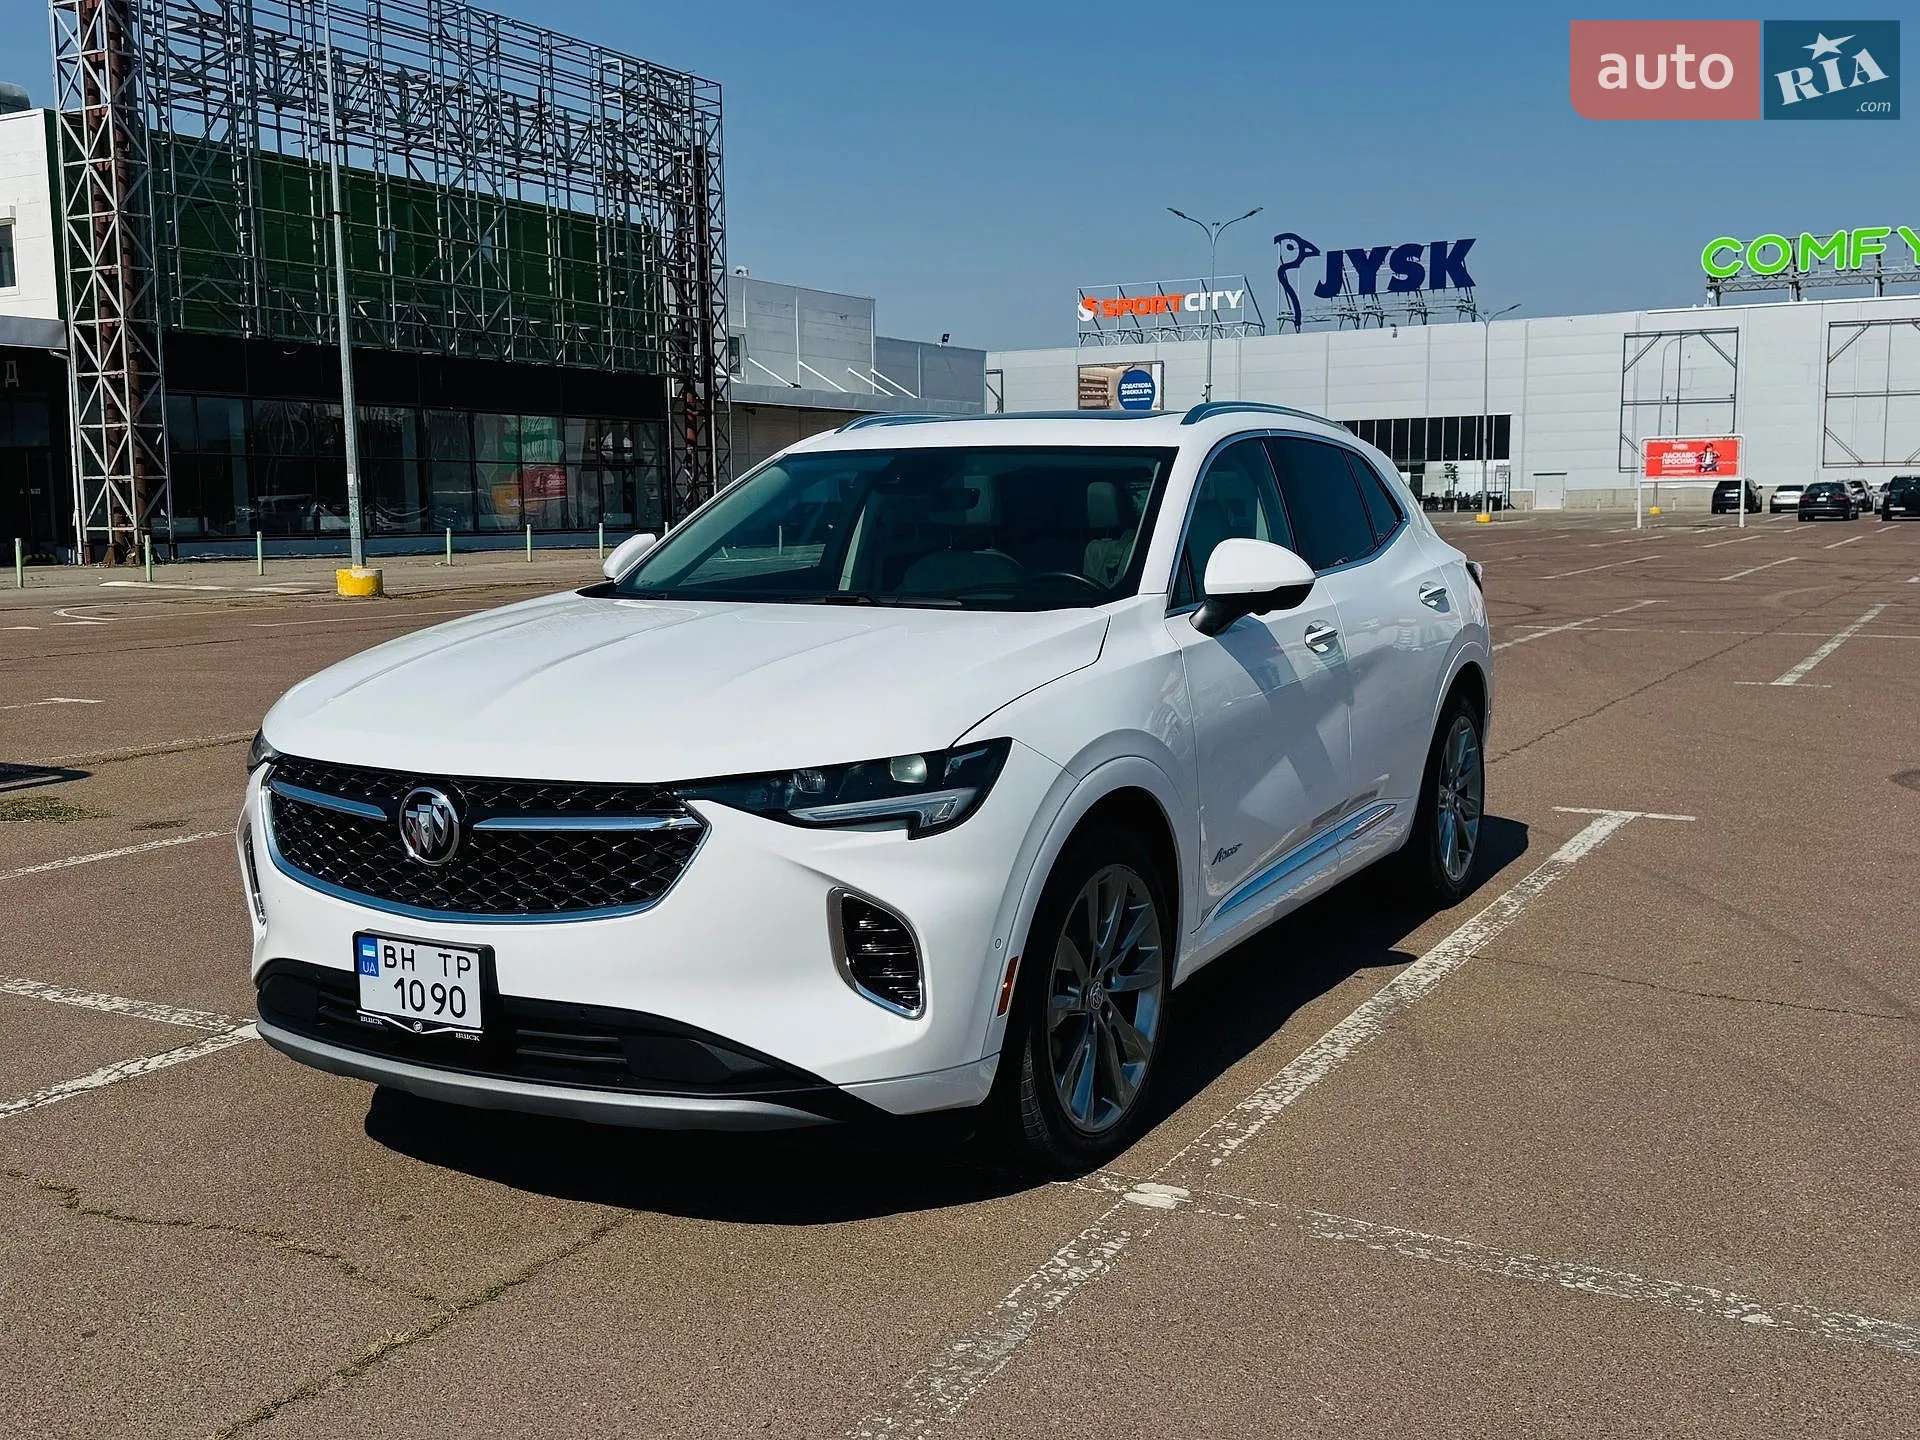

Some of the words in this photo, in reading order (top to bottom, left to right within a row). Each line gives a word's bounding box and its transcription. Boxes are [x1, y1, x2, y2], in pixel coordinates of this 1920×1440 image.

[1314, 238, 1477, 299] JYSK
[362, 961, 377, 974] UA
[383, 945, 415, 971] BH
[438, 953, 471, 979] TP
[394, 977, 466, 1018] 1090
[360, 1015, 383, 1026] BUICK
[455, 1032, 480, 1042] BUICK
